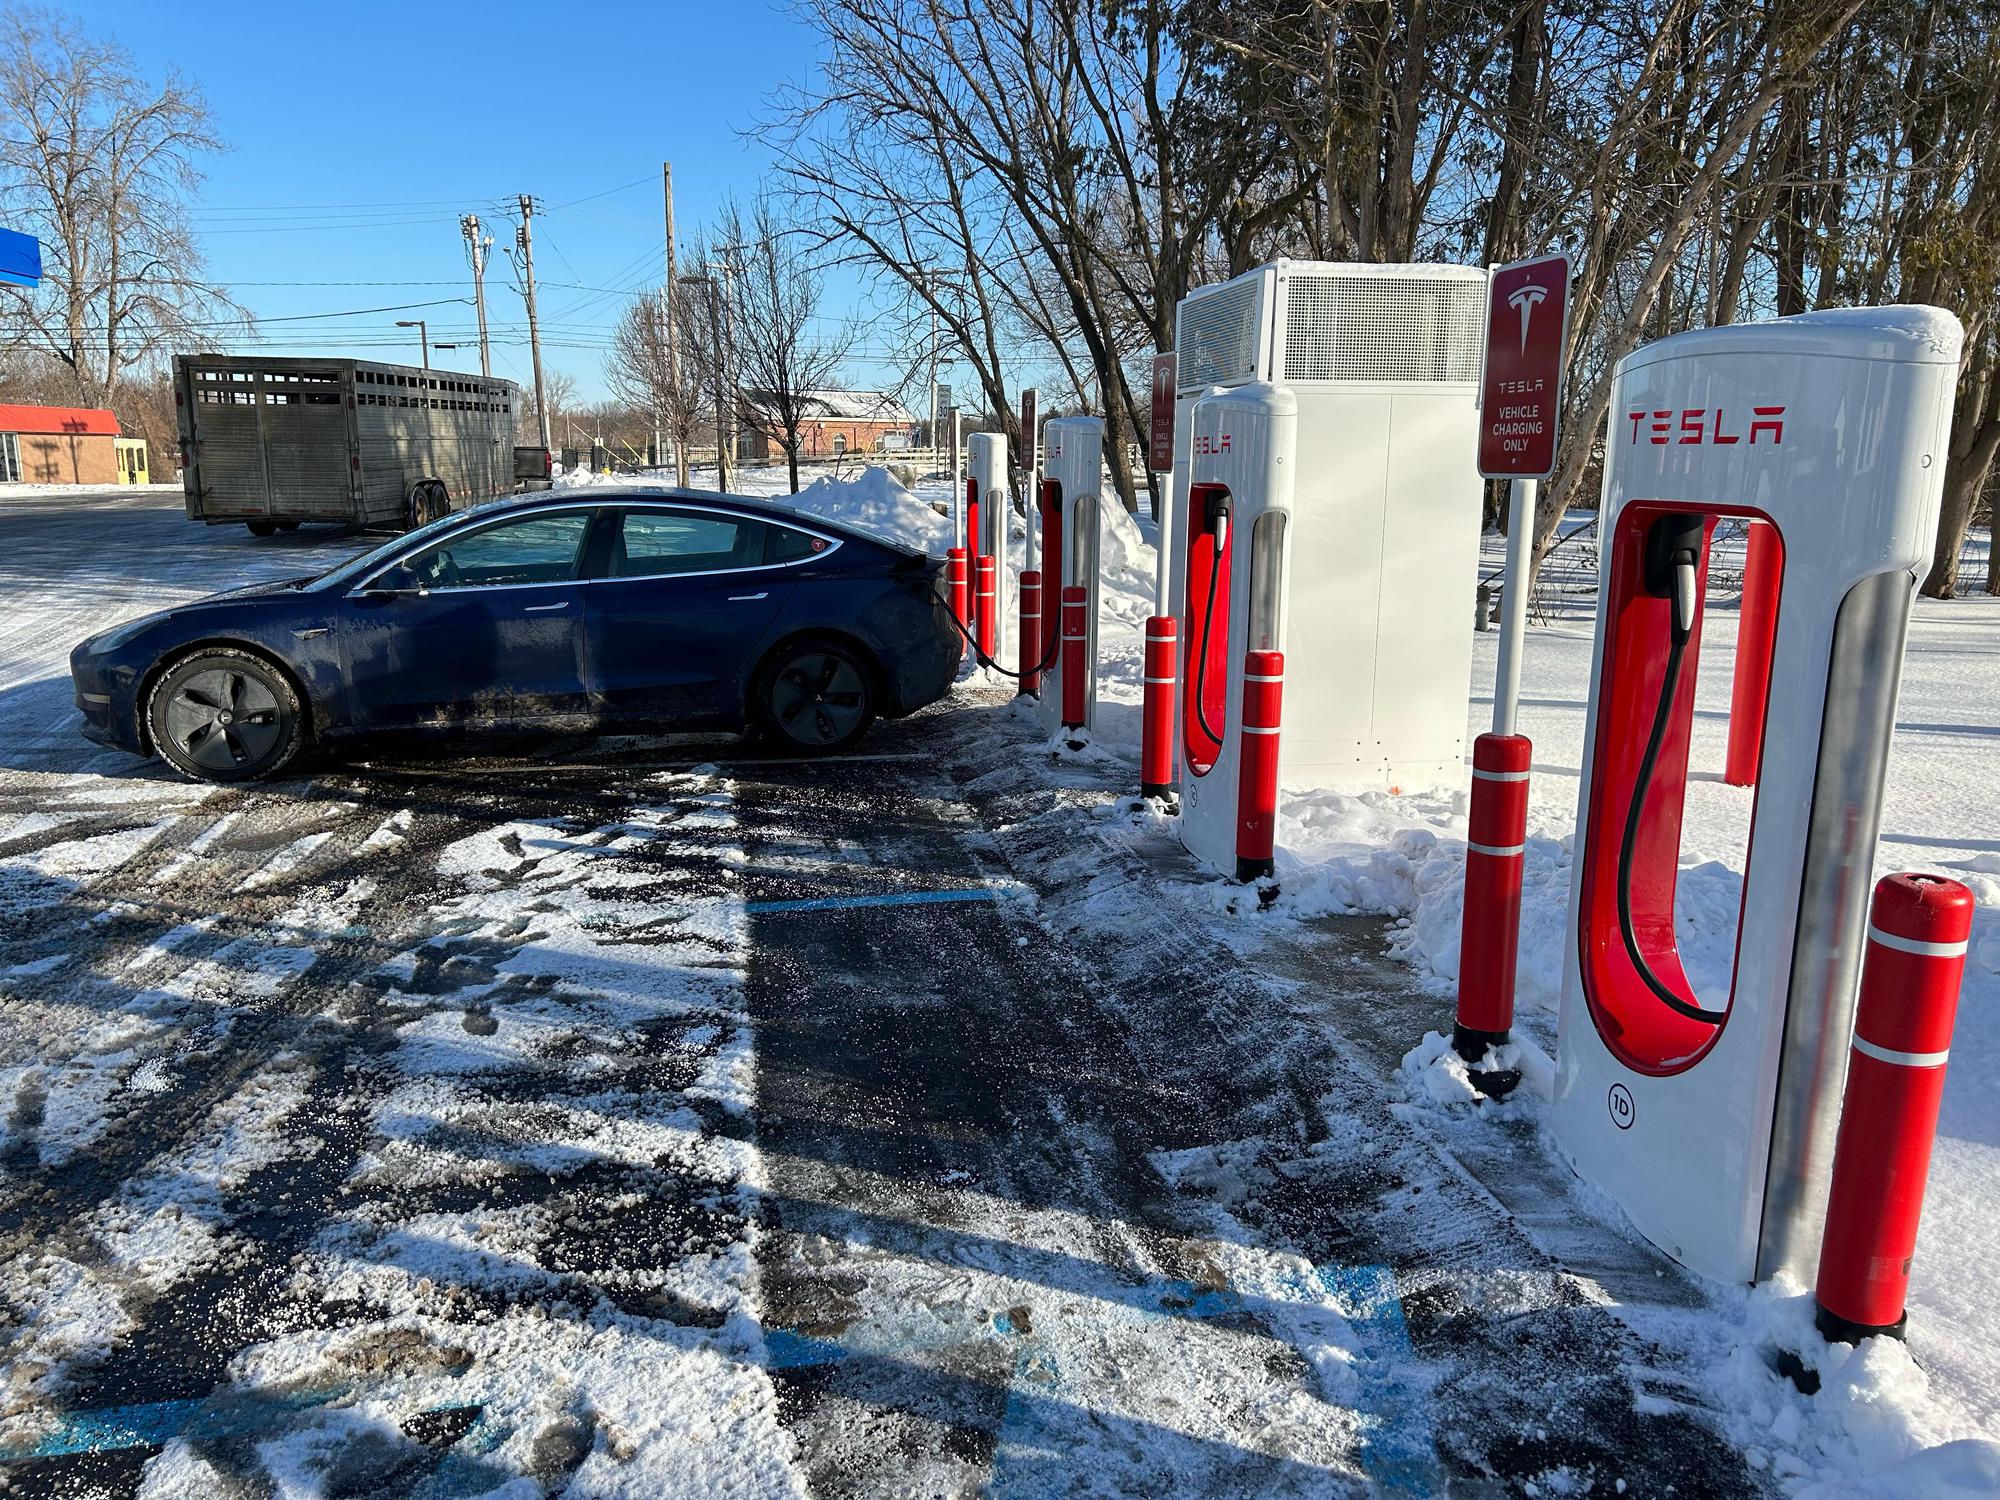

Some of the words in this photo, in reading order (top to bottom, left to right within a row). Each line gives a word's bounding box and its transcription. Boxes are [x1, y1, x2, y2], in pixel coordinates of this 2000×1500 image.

[1499, 379, 1543, 394] TESLA
[1499, 405, 1539, 419] VEHICLE
[1493, 421, 1543, 436] CHARGING
[1629, 406, 1786, 445] TESLA
[1194, 434, 1231, 454] ESLA
[1503, 439, 1529, 451] ONLY
[1614, 1094, 1629, 1116] 1D
